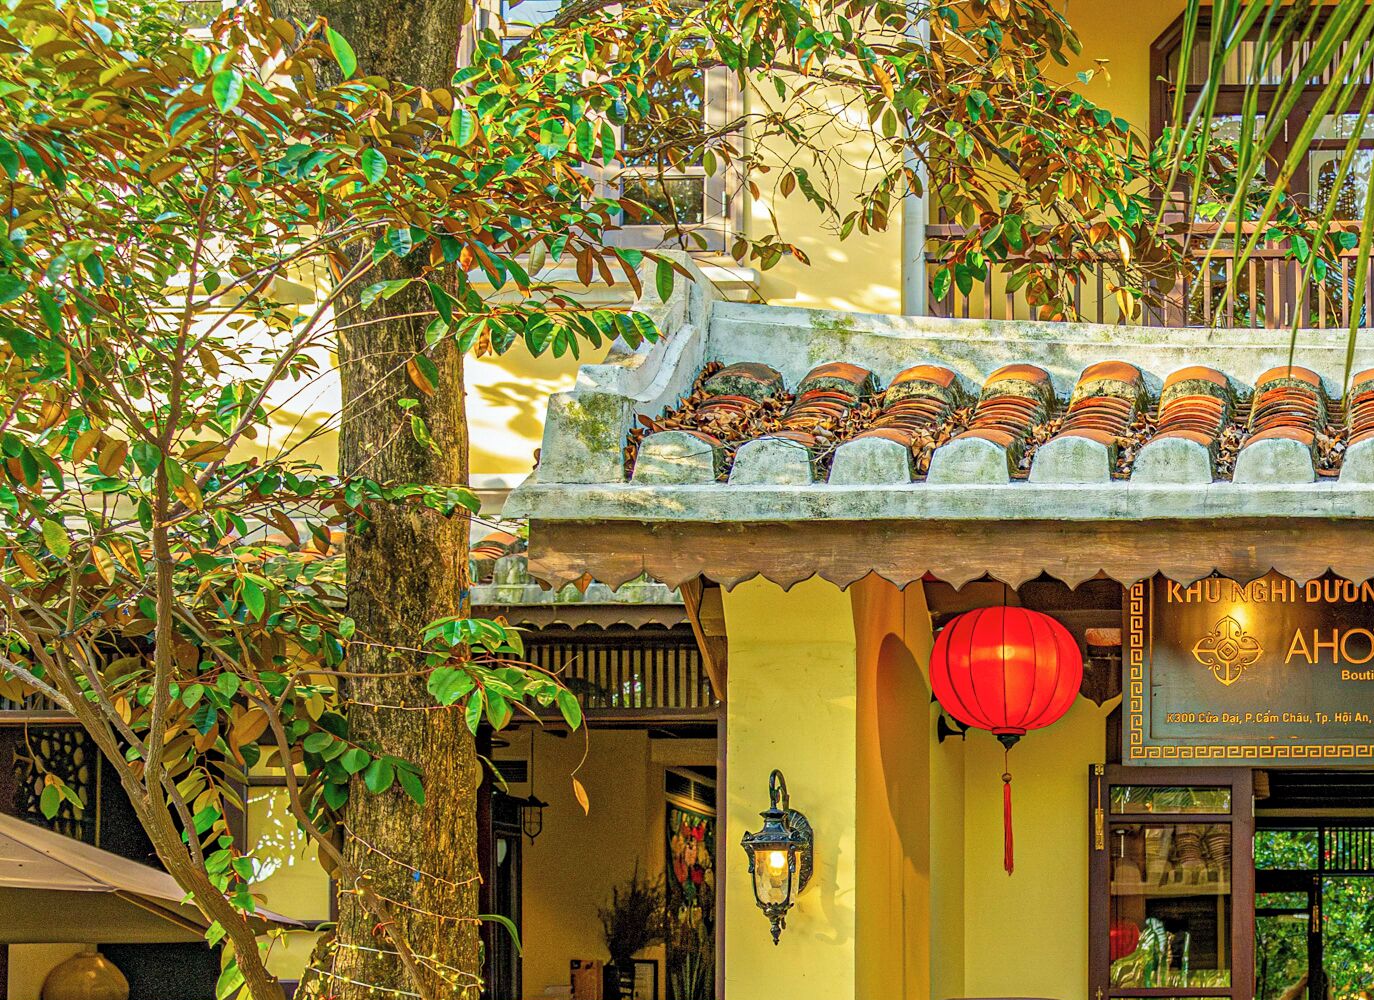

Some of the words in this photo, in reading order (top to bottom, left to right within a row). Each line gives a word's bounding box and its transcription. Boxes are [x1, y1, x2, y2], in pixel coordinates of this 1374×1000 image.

[1167, 713, 1195, 723] K300
[1315, 712, 1331, 725] Tp.
[1335, 712, 1352, 725] Hội
[1355, 712, 1372, 723] An,
